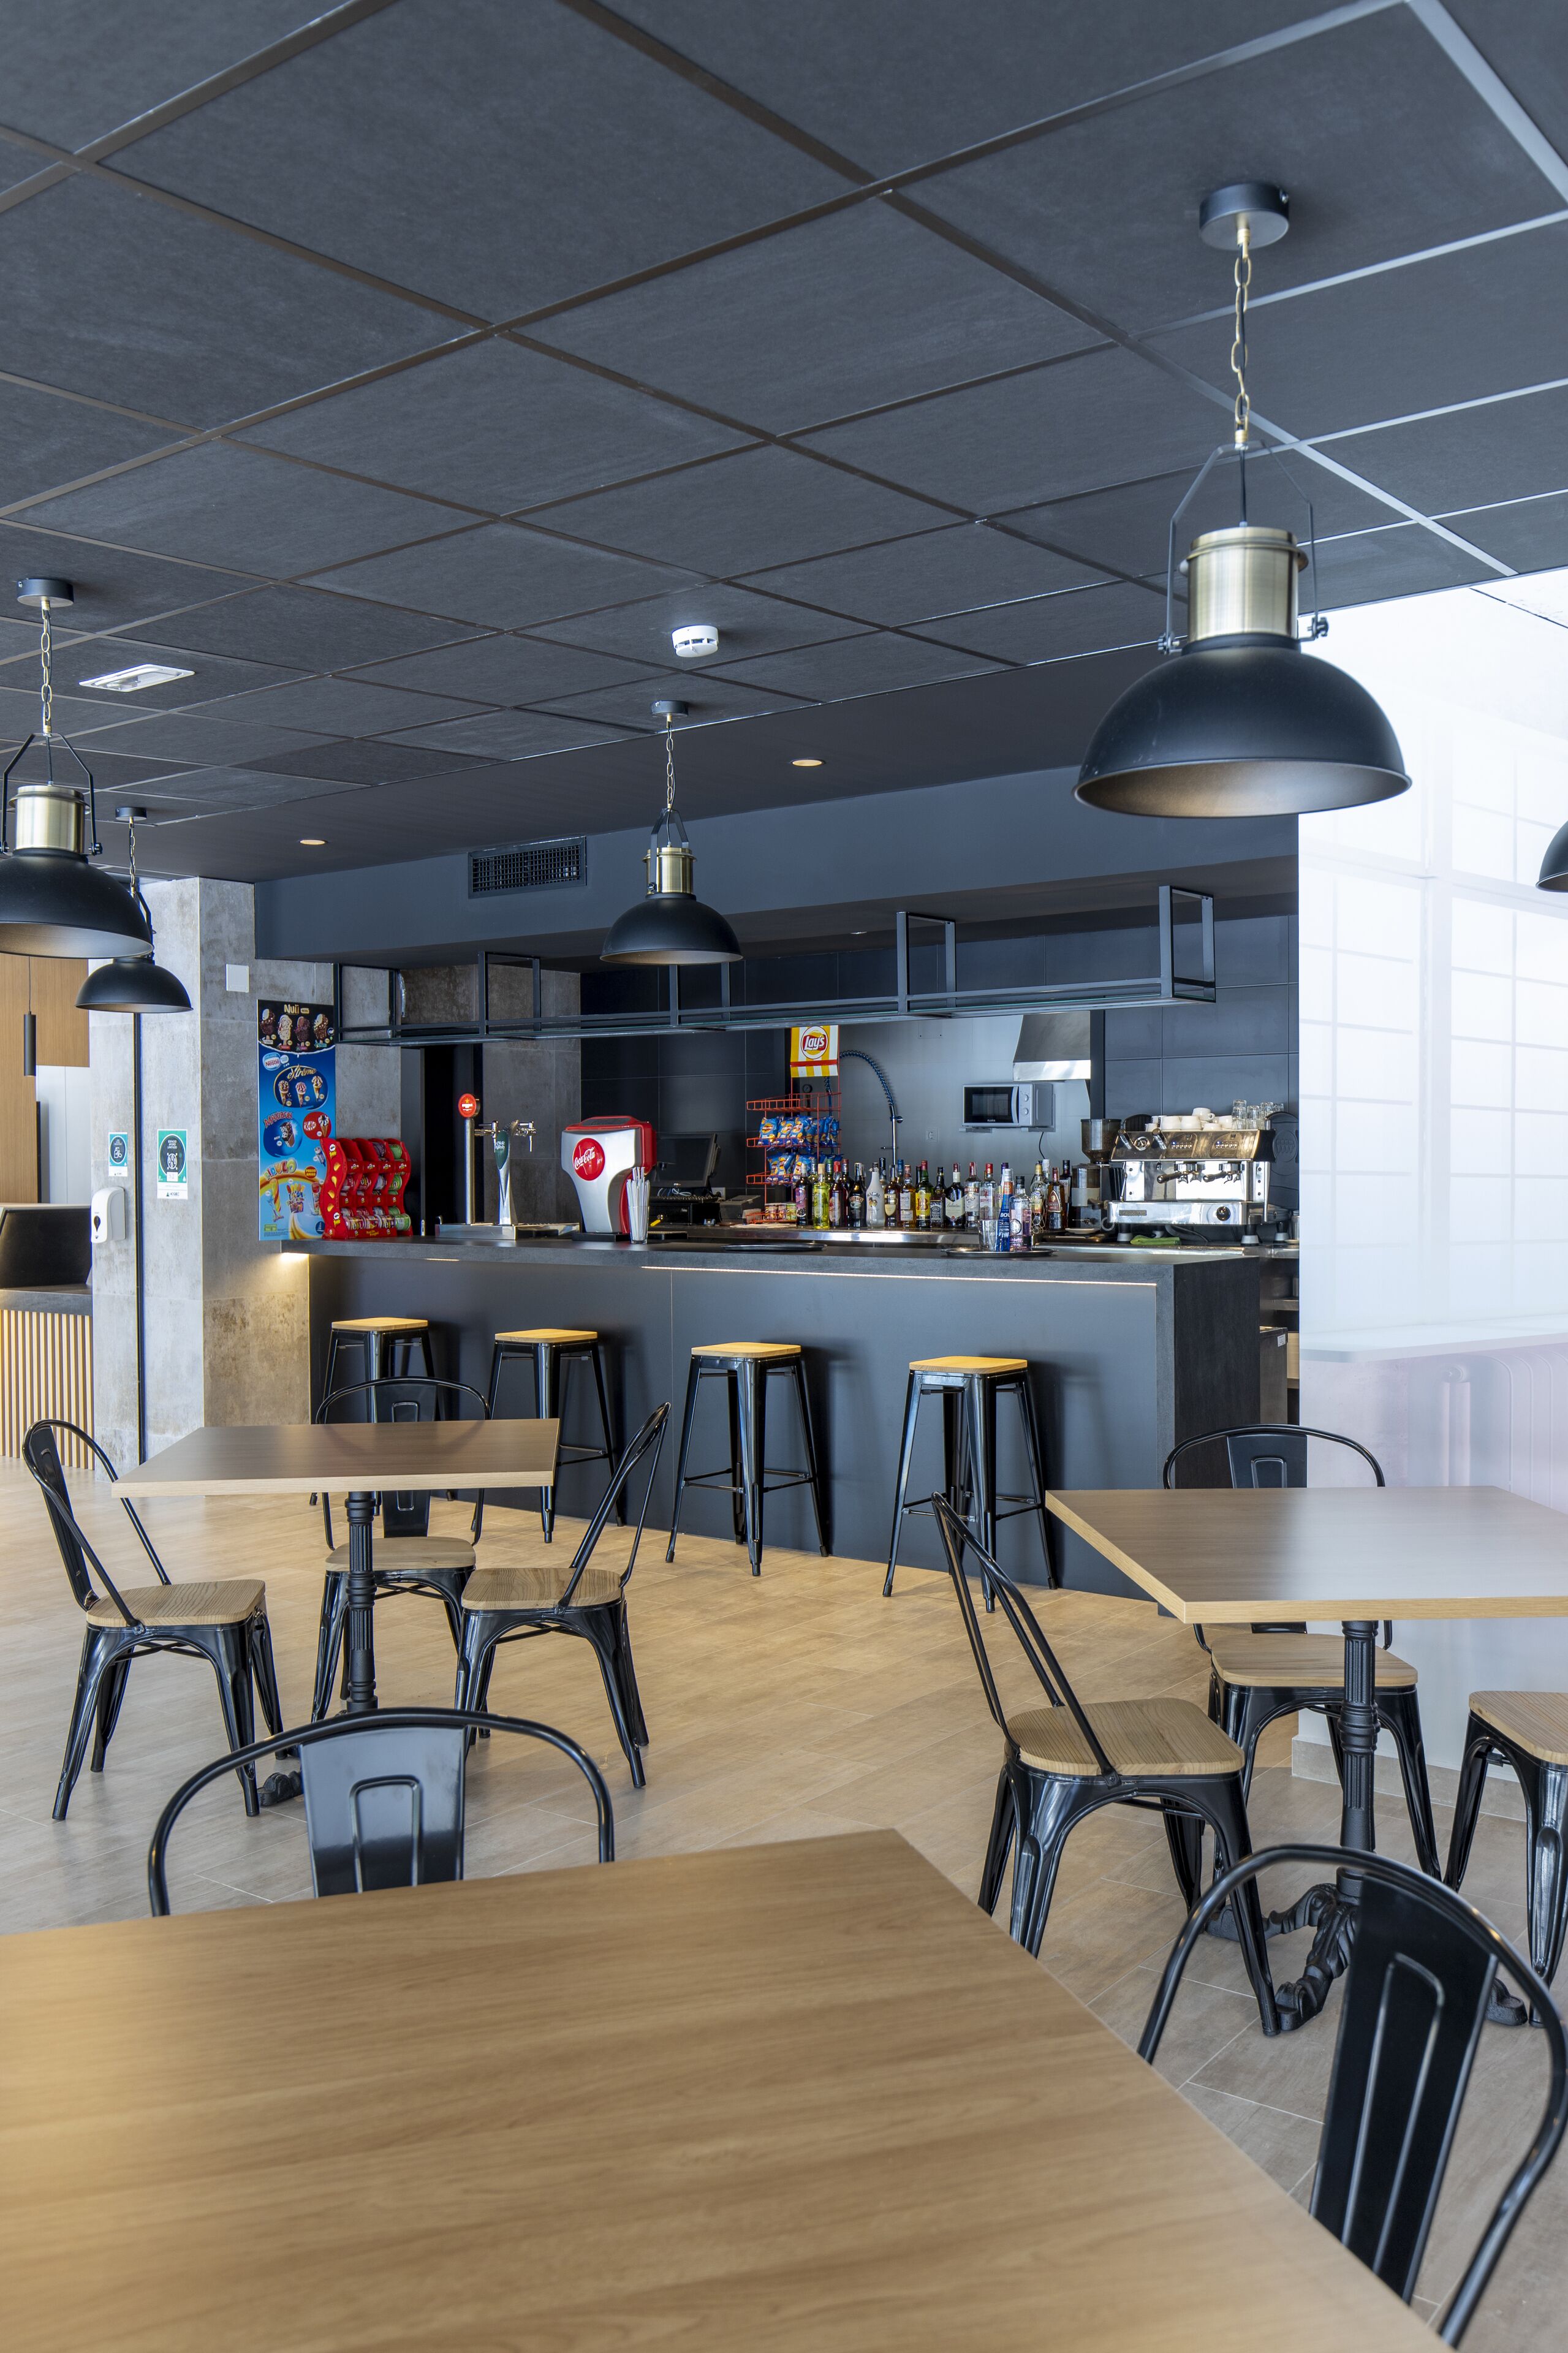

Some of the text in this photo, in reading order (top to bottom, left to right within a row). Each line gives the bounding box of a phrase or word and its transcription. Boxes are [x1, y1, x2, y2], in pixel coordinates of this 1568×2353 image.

[804, 1035, 825, 1050] Lay's
[263, 1112, 292, 1128] MAXIBON
[575, 1146, 596, 1170] Coca-Cola
